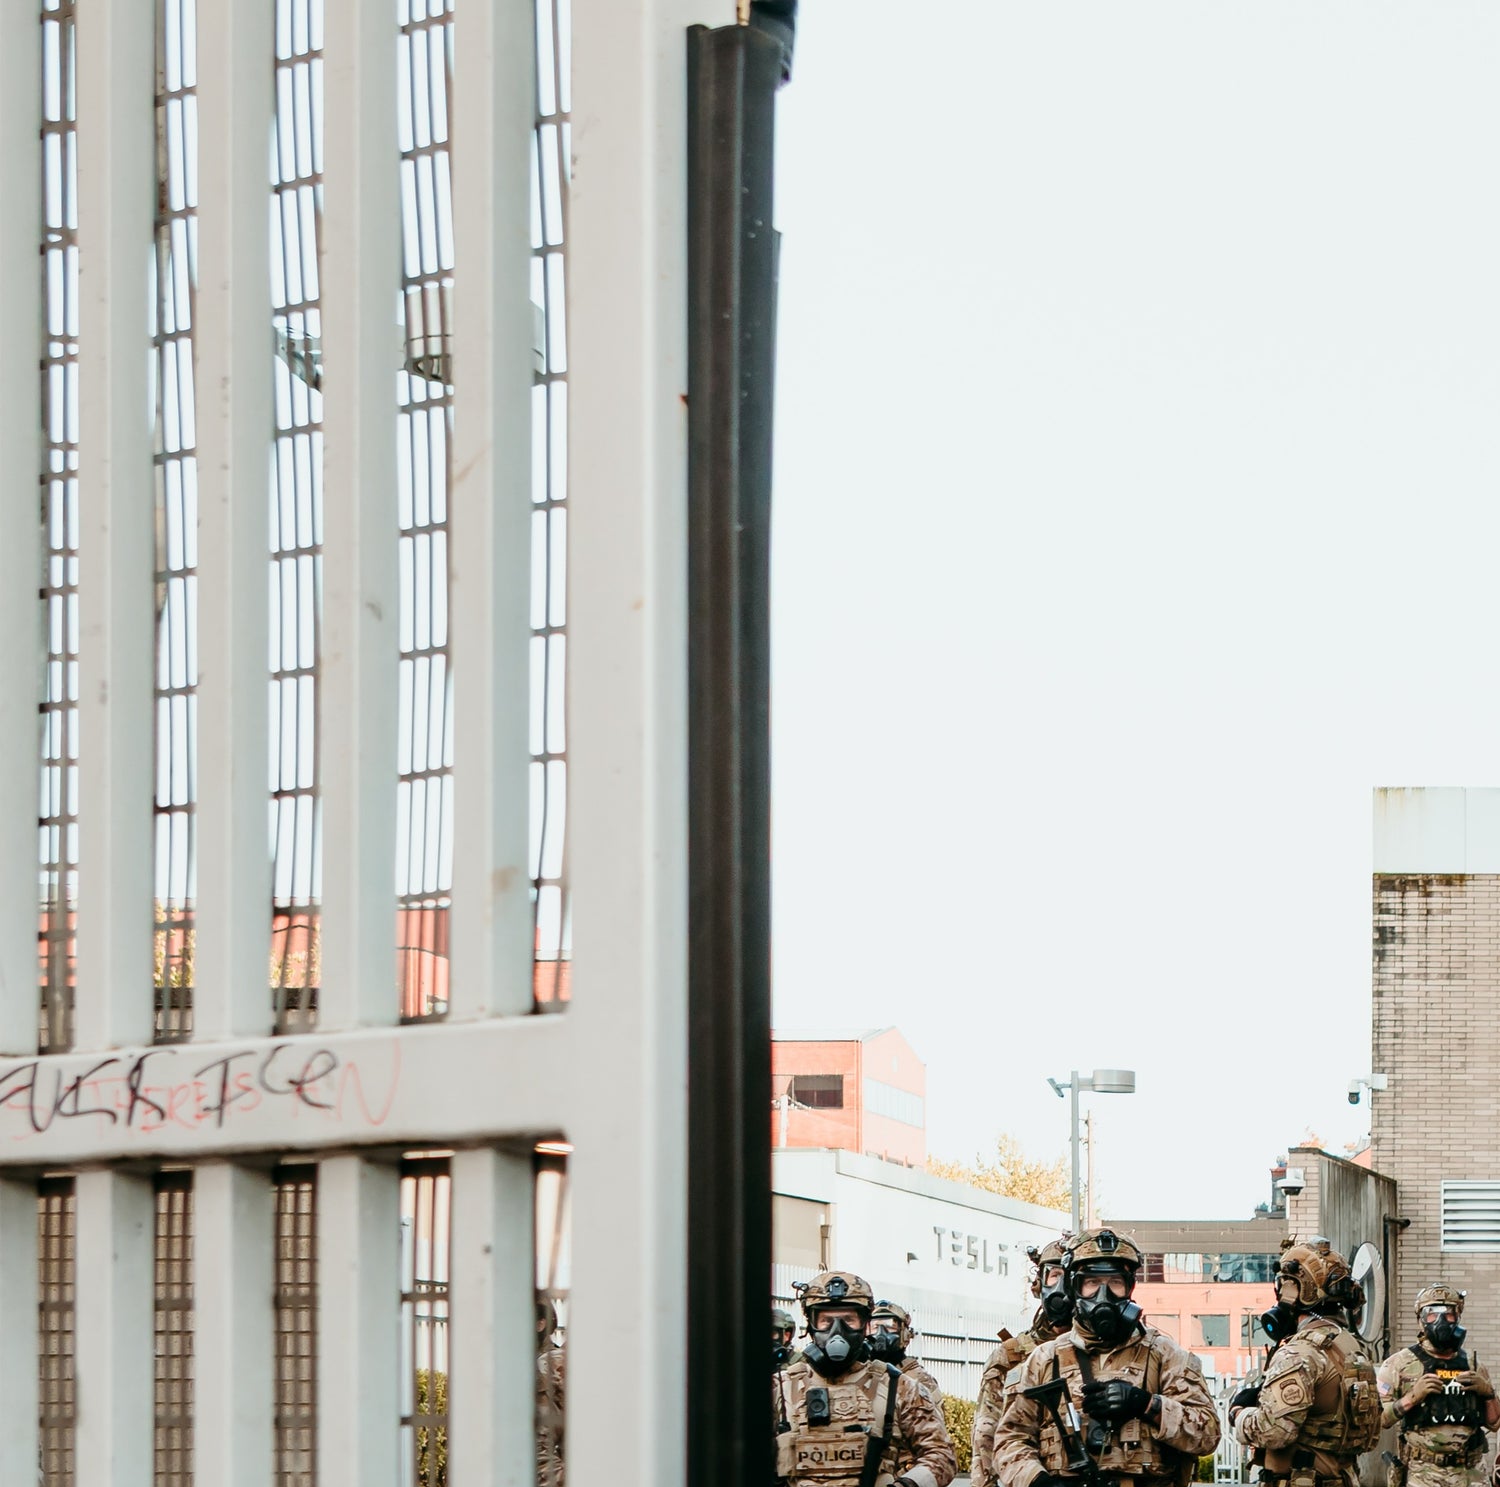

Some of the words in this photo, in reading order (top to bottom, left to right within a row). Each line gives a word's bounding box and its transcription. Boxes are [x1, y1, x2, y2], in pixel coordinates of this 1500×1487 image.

[933, 1225, 1009, 1276] TESLA
[1437, 1369, 1461, 1379] POLIC
[798, 1449, 863, 1463] POLICE
